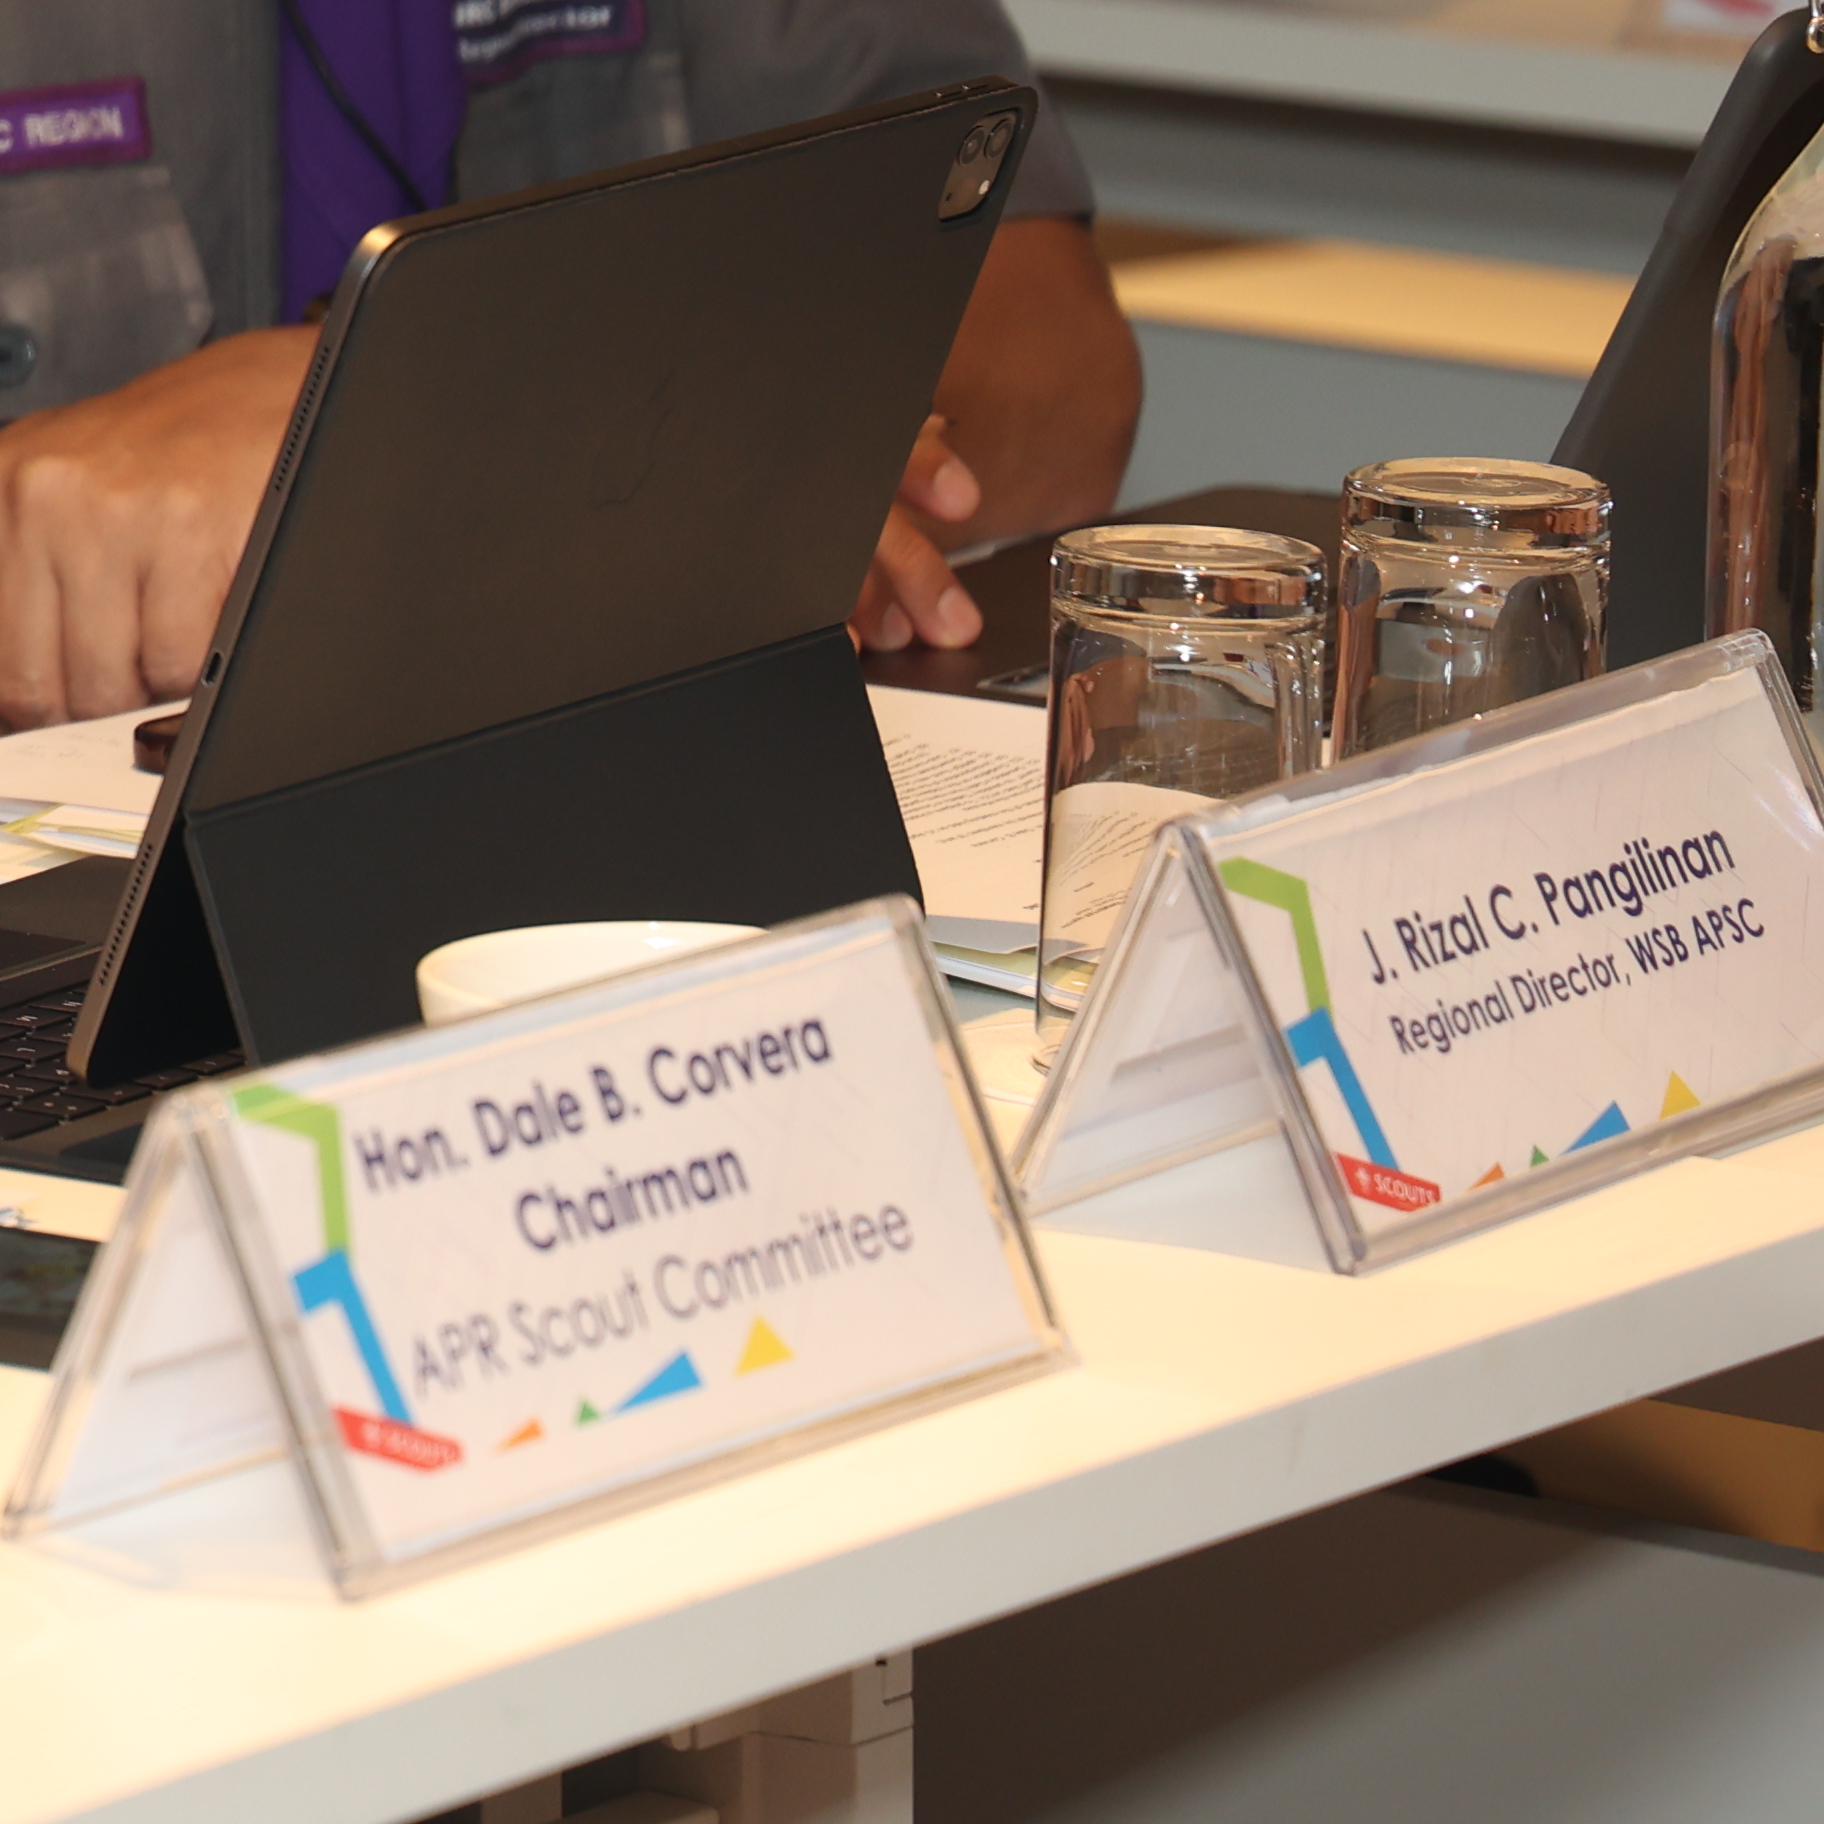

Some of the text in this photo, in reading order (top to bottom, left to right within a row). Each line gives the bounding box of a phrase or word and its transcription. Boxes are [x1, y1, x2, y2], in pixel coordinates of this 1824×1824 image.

[22, 105, 125, 147] REGION
[1362, 828, 1736, 986] J. Rizal C. Pangilinan
[1390, 897, 1766, 1055] Regional Director, WSB APSC
[353, 1014, 834, 1196] Hon. Dale B. Corvera
[513, 1146, 750, 1253] Chairman
[410, 1200, 917, 1401] APR Scout Committee
